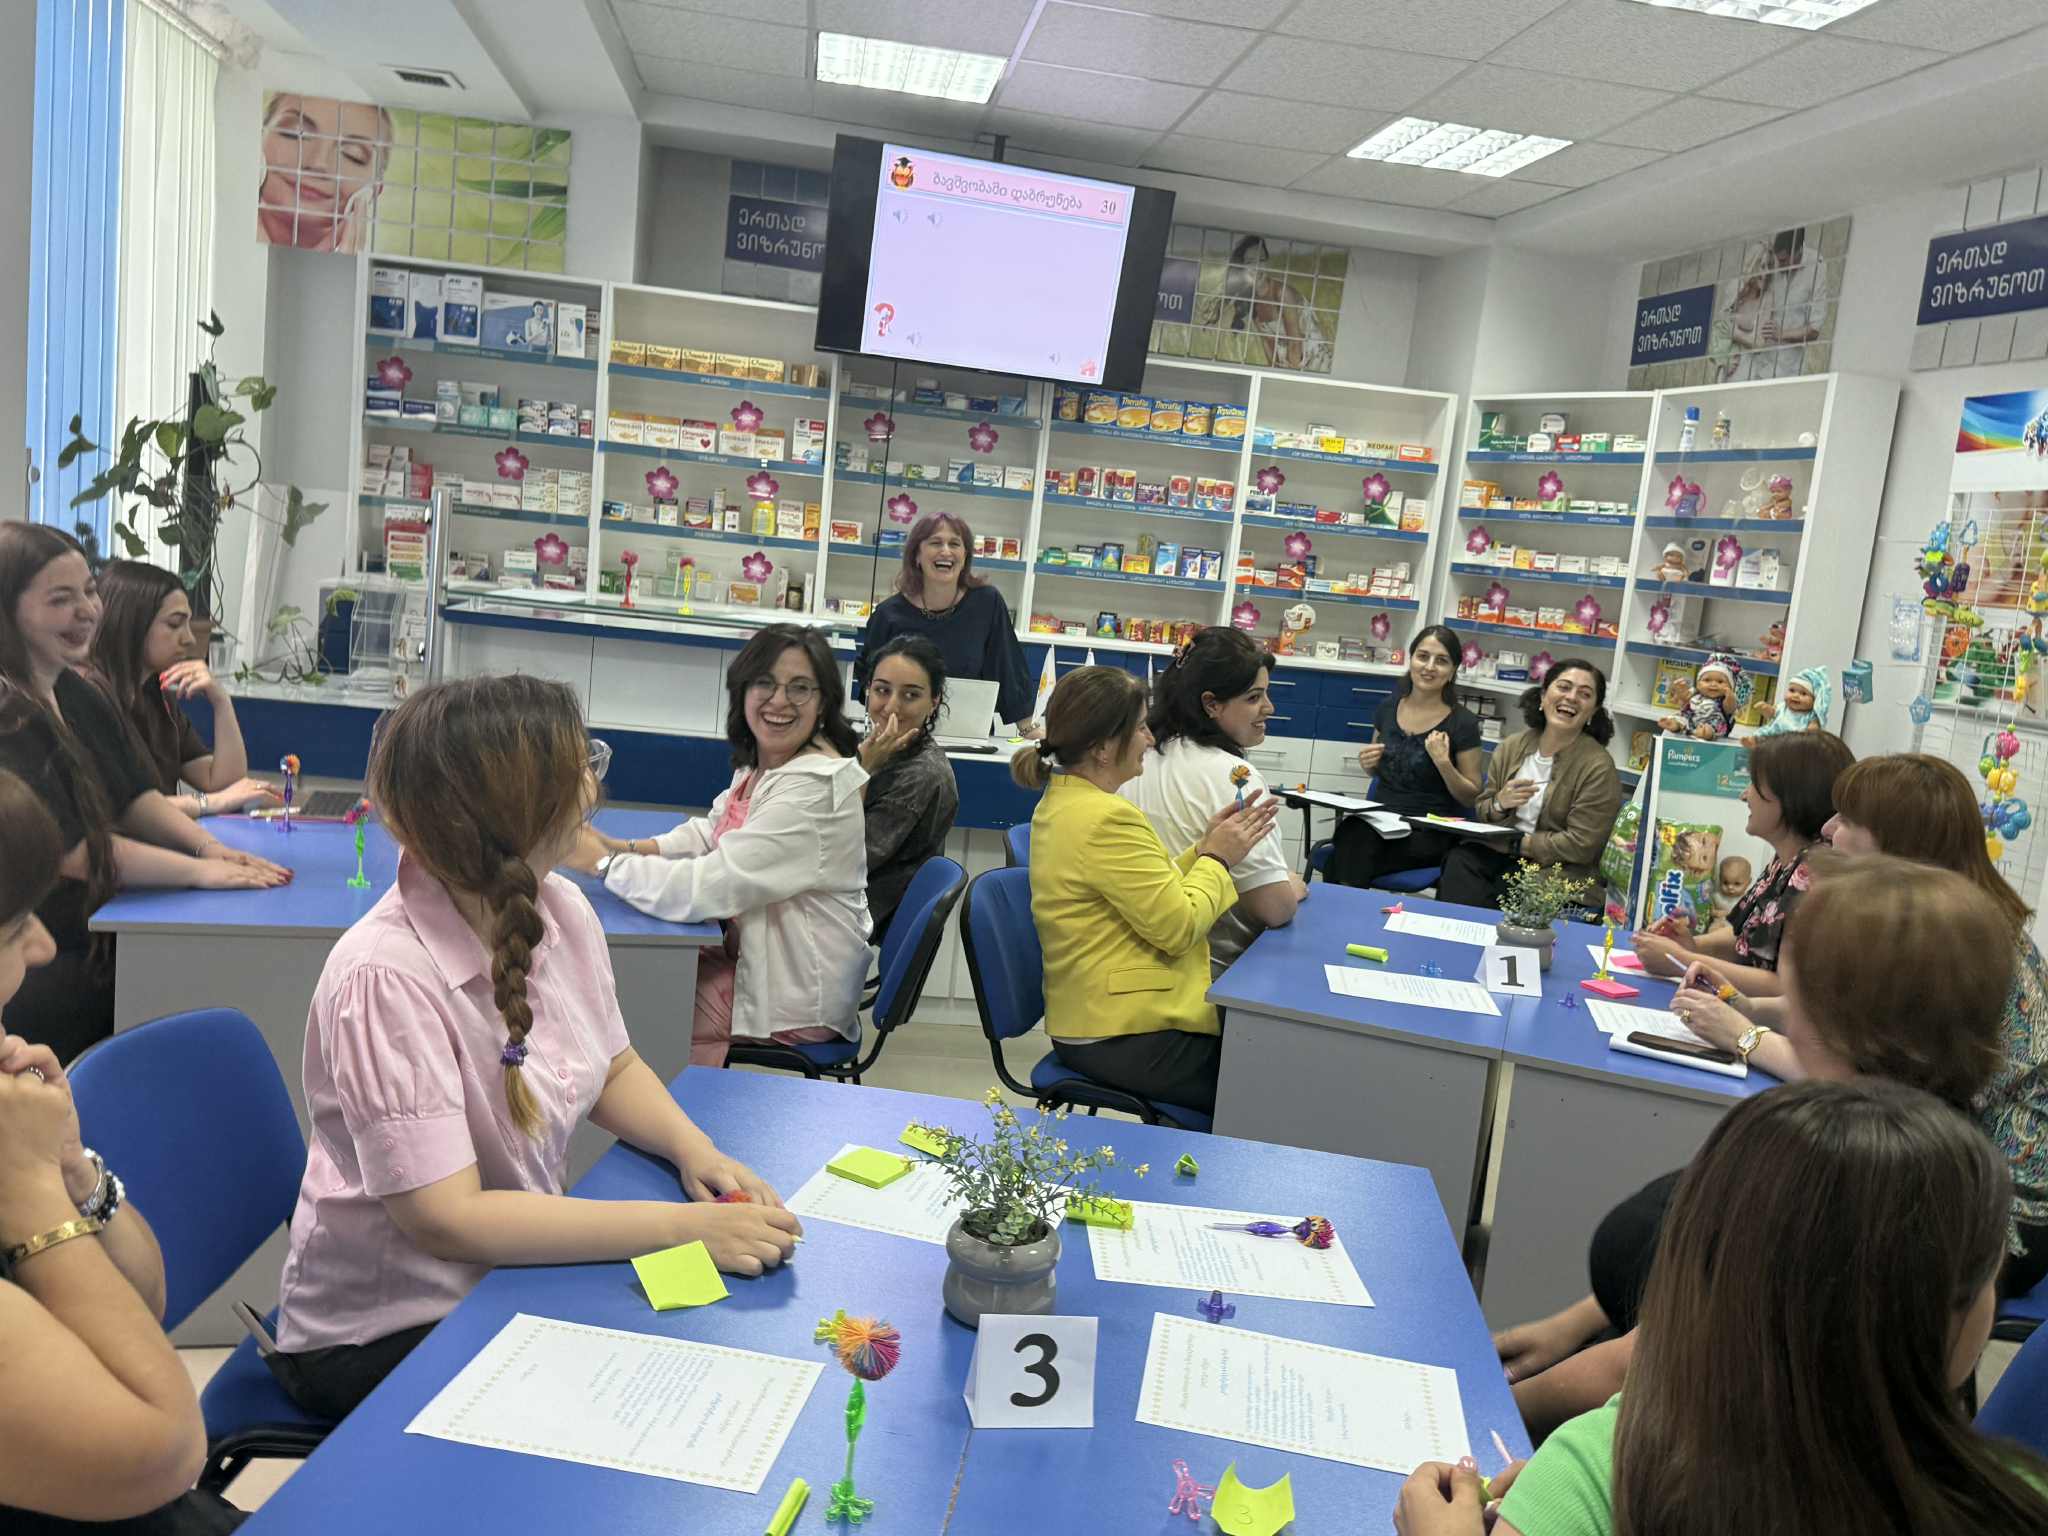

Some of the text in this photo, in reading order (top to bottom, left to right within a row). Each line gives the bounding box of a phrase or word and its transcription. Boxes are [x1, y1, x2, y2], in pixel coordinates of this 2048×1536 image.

[932, 171, 1007, 197] ბავშვობაში
[1100, 199, 1117, 215] 30
[738, 207, 806, 233] ერთად
[1936, 240, 2008, 275] ერთად
[1930, 267, 2045, 308] ვიზრუნოთ
[1640, 303, 1682, 328] ერთად
[1637, 325, 1703, 353] ვიზრუნოთ
[1667, 748, 1701, 763] Pampers
[1499, 955, 1525, 988] 1
[1010, 1333, 1060, 1407] 3
